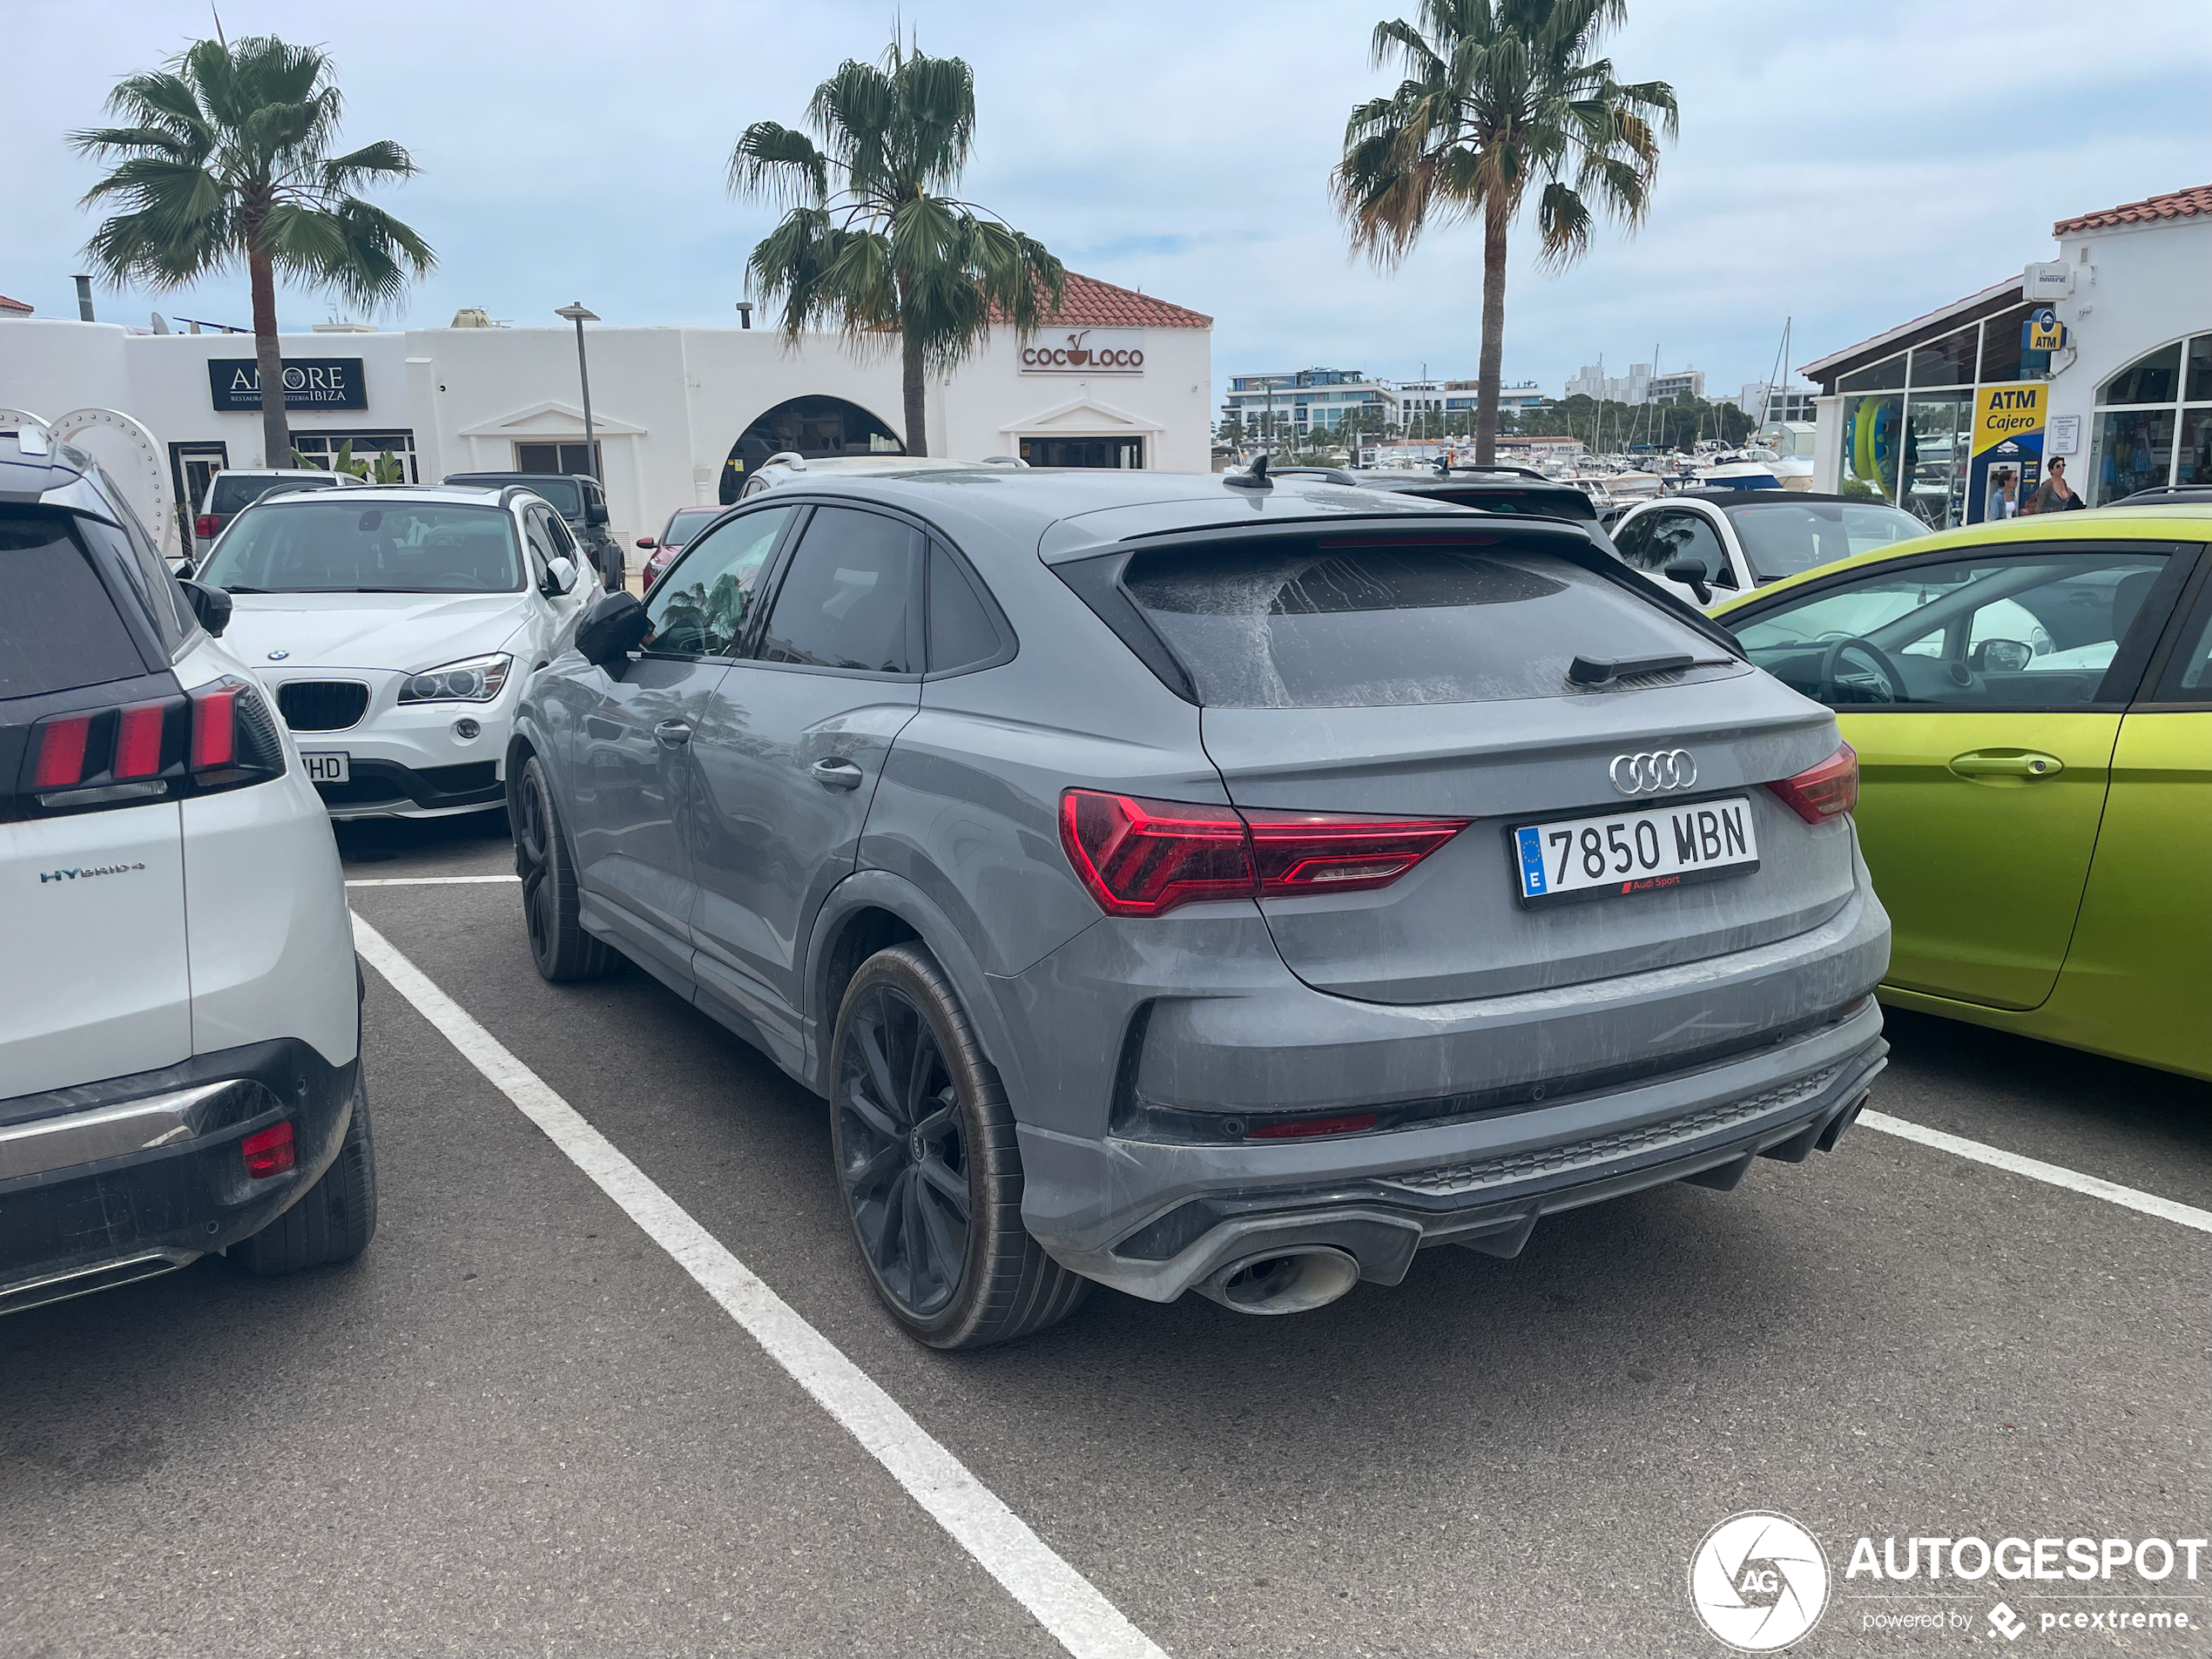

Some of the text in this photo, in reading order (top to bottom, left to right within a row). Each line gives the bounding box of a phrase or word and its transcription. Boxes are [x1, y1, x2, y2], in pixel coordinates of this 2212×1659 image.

[2035, 336, 2056, 348] ATM
[1089, 348, 1144, 367] LOCO
[309, 390, 347, 401] IBIZA
[1989, 389, 2036, 410] ATM
[1986, 414, 2035, 432] Cajero
[1548, 806, 1747, 885] 7850 MBN
[1529, 872, 1541, 887] E
[1633, 874, 1681, 890] Audi Sport
